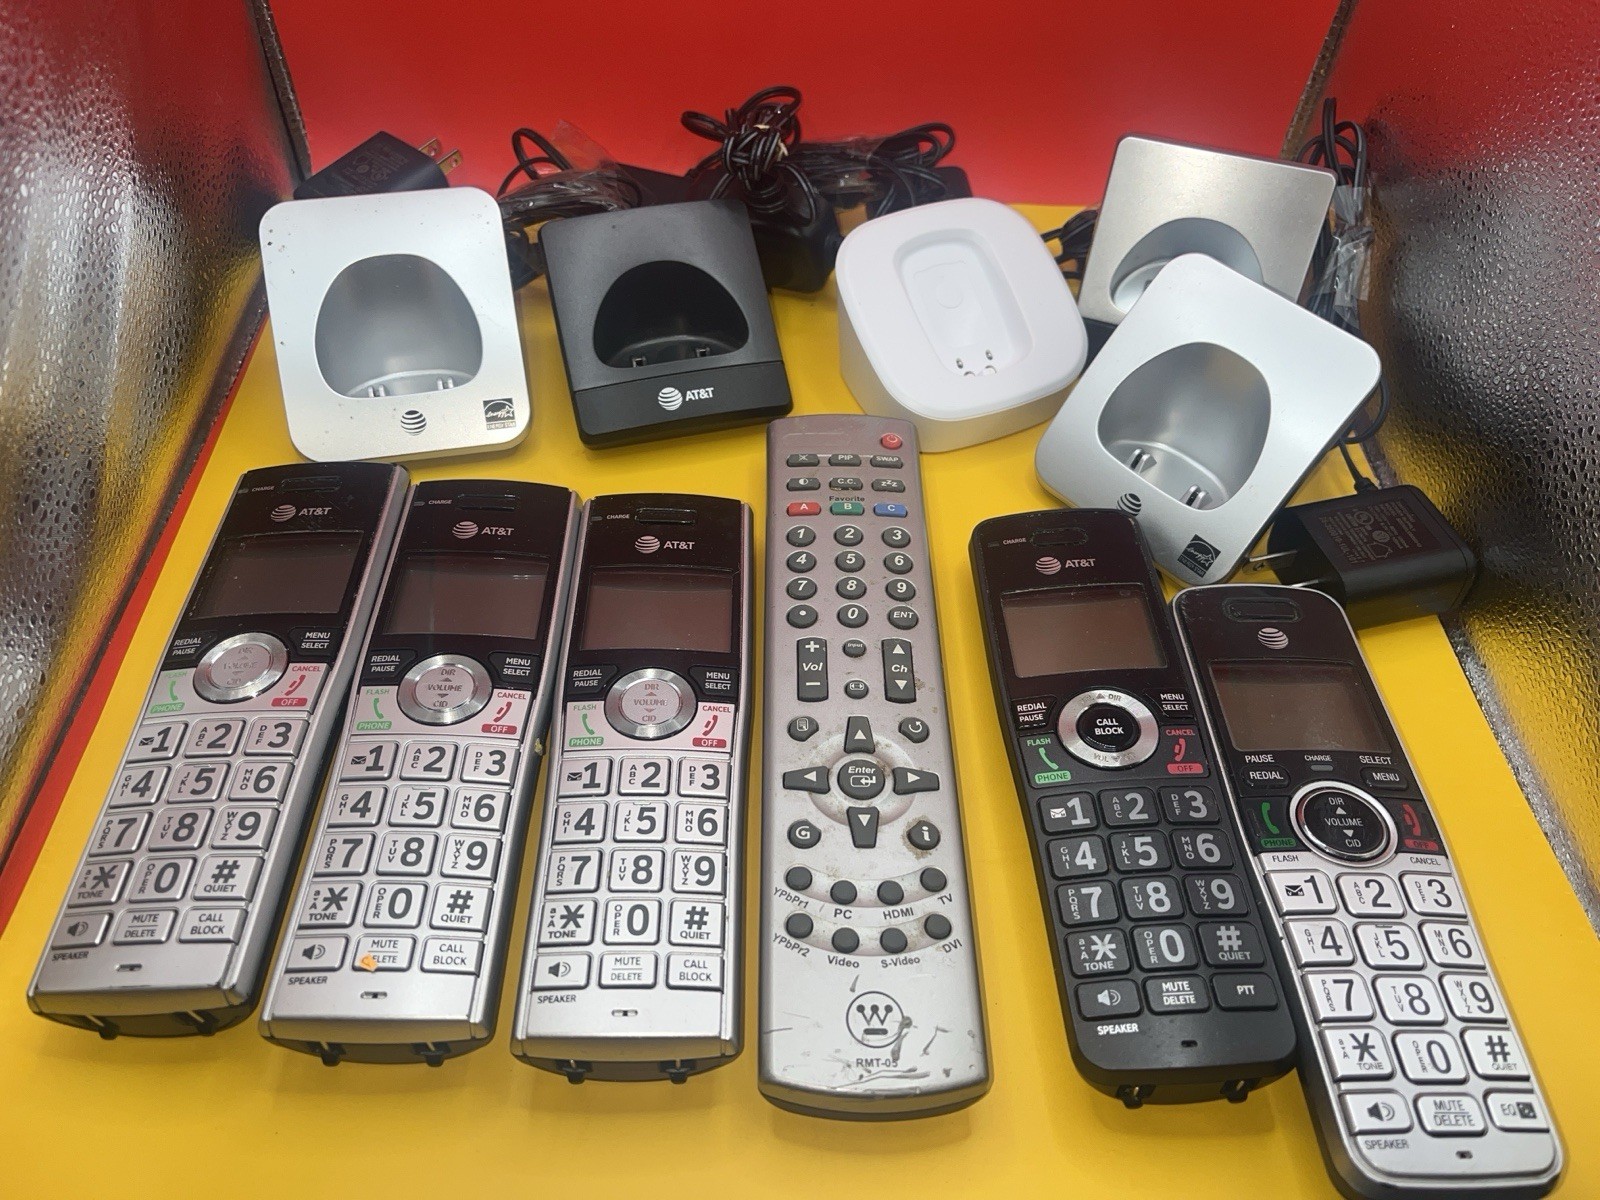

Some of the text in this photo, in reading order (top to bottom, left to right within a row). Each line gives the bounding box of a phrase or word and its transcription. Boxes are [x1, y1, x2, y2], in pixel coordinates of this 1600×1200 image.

[686, 387, 714, 401] AT&T
[299, 507, 331, 516] AT&T
[481, 527, 514, 535] AT&T
[797, 529, 804, 538] 1
[845, 528, 854, 538] 2
[892, 530, 902, 540] 3
[664, 541, 695, 549] AT&T
[796, 554, 806, 564] 4
[846, 554, 855, 564] 5
[895, 556, 903, 565] 6
[1065, 558, 1095, 568] AT&T
[798, 581, 807, 590] 7
[846, 580, 856, 590] 8
[897, 582, 906, 592] 9
[848, 608, 858, 618] 0
[174, 637, 201, 646] REDIAL
[172, 648, 195, 656] PAUSE
[506, 658, 530, 666] MENU
[803, 662, 823, 671] Vol
[503, 668, 530, 676] SELECT
[573, 669, 602, 677] REDIAL
[892, 664, 908, 673] Ch
[497, 692, 526, 700] CANCEL
[702, 705, 731, 713] CANCEL
[1017, 702, 1047, 712] REDIAL
[1019, 713, 1043, 722] PAUSE
[359, 722, 389, 730] PHONE
[1095, 727, 1124, 735] BLOCK
[152, 726, 172, 752] 1
[207, 724, 231, 748] 2
[268, 723, 292, 748] 3
[571, 737, 602, 746] PHONE
[1027, 738, 1051, 746] FLASH
[366, 745, 384, 771] 1
[423, 746, 446, 772] 2
[485, 750, 506, 776] 3
[1245, 755, 1274, 763] PAUSE
[1359, 756, 1392, 764] SELECT
[641, 762, 661, 788] 2
[848, 766, 875, 774] Enter
[253, 766, 277, 793] 6
[582, 762, 600, 789] 1
[701, 764, 720, 790] 3
[1038, 772, 1068, 781] PHONE
[1250, 771, 1283, 780] REDIAL
[1372, 773, 1399, 781] MENU
[131, 770, 154, 797] 4
[190, 767, 216, 795] 5
[350, 790, 372, 818] 4
[413, 792, 436, 820] 5
[1184, 791, 1208, 818] 3
[1328, 797, 1345, 805] DIR
[474, 794, 496, 822] 6
[1067, 797, 1090, 826] 1
[1124, 793, 1148, 820] 2
[235, 811, 261, 840] 9
[574, 808, 595, 835] 4
[636, 807, 656, 834] 5
[698, 808, 718, 836] 6
[1325, 818, 1363, 826] VOLUME
[172, 812, 199, 842] 8
[114, 818, 137, 847] 7
[1196, 833, 1221, 863] 6
[1345, 839, 1361, 848] CID
[342, 838, 363, 868] 7
[400, 837, 424, 866] 8
[465, 841, 488, 870] 9
[1075, 841, 1097, 870] 4
[1134, 837, 1158, 866] 5
[1272, 855, 1299, 863] FLASH
[1410, 857, 1441, 865] CANCEL
[571, 856, 591, 885] 7
[631, 855, 653, 884] 8
[694, 856, 715, 886] 9
[154, 862, 180, 893] 0
[204, 884, 236, 893] QUIET
[1210, 878, 1235, 909] 9
[1303, 875, 1323, 904] 1
[1364, 879, 1392, 908] 2
[1427, 879, 1452, 907] 3
[77, 890, 103, 898] TONE
[774, 887, 809, 909] YPbPr1
[937, 893, 953, 905] TV
[1147, 882, 1171, 912] 8
[388, 888, 413, 919] 0
[1081, 886, 1102, 918] 7
[132, 914, 159, 922] MUTE
[199, 914, 223, 922] CALL
[309, 913, 337, 921] TONE
[834, 908, 852, 919] PC
[883, 907, 914, 920] HDMI
[441, 915, 472, 924] QUIET
[627, 904, 649, 936] 0
[124, 928, 156, 937] DELETE
[190, 925, 225, 935] BLOCK
[548, 930, 576, 939] TONE
[680, 931, 710, 940] QUIET
[371, 939, 398, 948] MUTE
[772, 933, 810, 957] YPbPr2
[942, 939, 962, 953] DVI
[1159, 929, 1185, 962] 0
[1321, 926, 1342, 956] 4
[1386, 930, 1410, 961] 5
[1448, 928, 1473, 958] 6
[439, 944, 464, 953] CALL
[52, 951, 89, 961] SPEAKER
[433, 956, 466, 965] BLOCK
[1219, 952, 1251, 960] QUIET
[614, 957, 641, 966] MUTE
[684, 959, 707, 969] CALL
[827, 955, 859, 968] Video
[881, 956, 920, 968] S-Video
[1084, 961, 1114, 970] TONE
[288, 976, 327, 984] SPEAKER
[611, 972, 642, 981] DELETE
[679, 972, 712, 982] BLOCK
[1162, 981, 1190, 992] MUTE
[1237, 986, 1255, 995] PTT
[538, 994, 576, 1003] SPEAKER
[1163, 995, 1196, 1005] DELETE
[1332, 979, 1354, 1011] 7
[1404, 983, 1431, 1016] 8
[1468, 981, 1494, 1014] 9
[1097, 1023, 1139, 1035] SPEAKER
[1426, 1040, 1452, 1074] 0
[1434, 1100, 1465, 1111] MUTE
[1434, 1115, 1475, 1127] DELETE
[1365, 1139, 1409, 1150] SPEAKER
